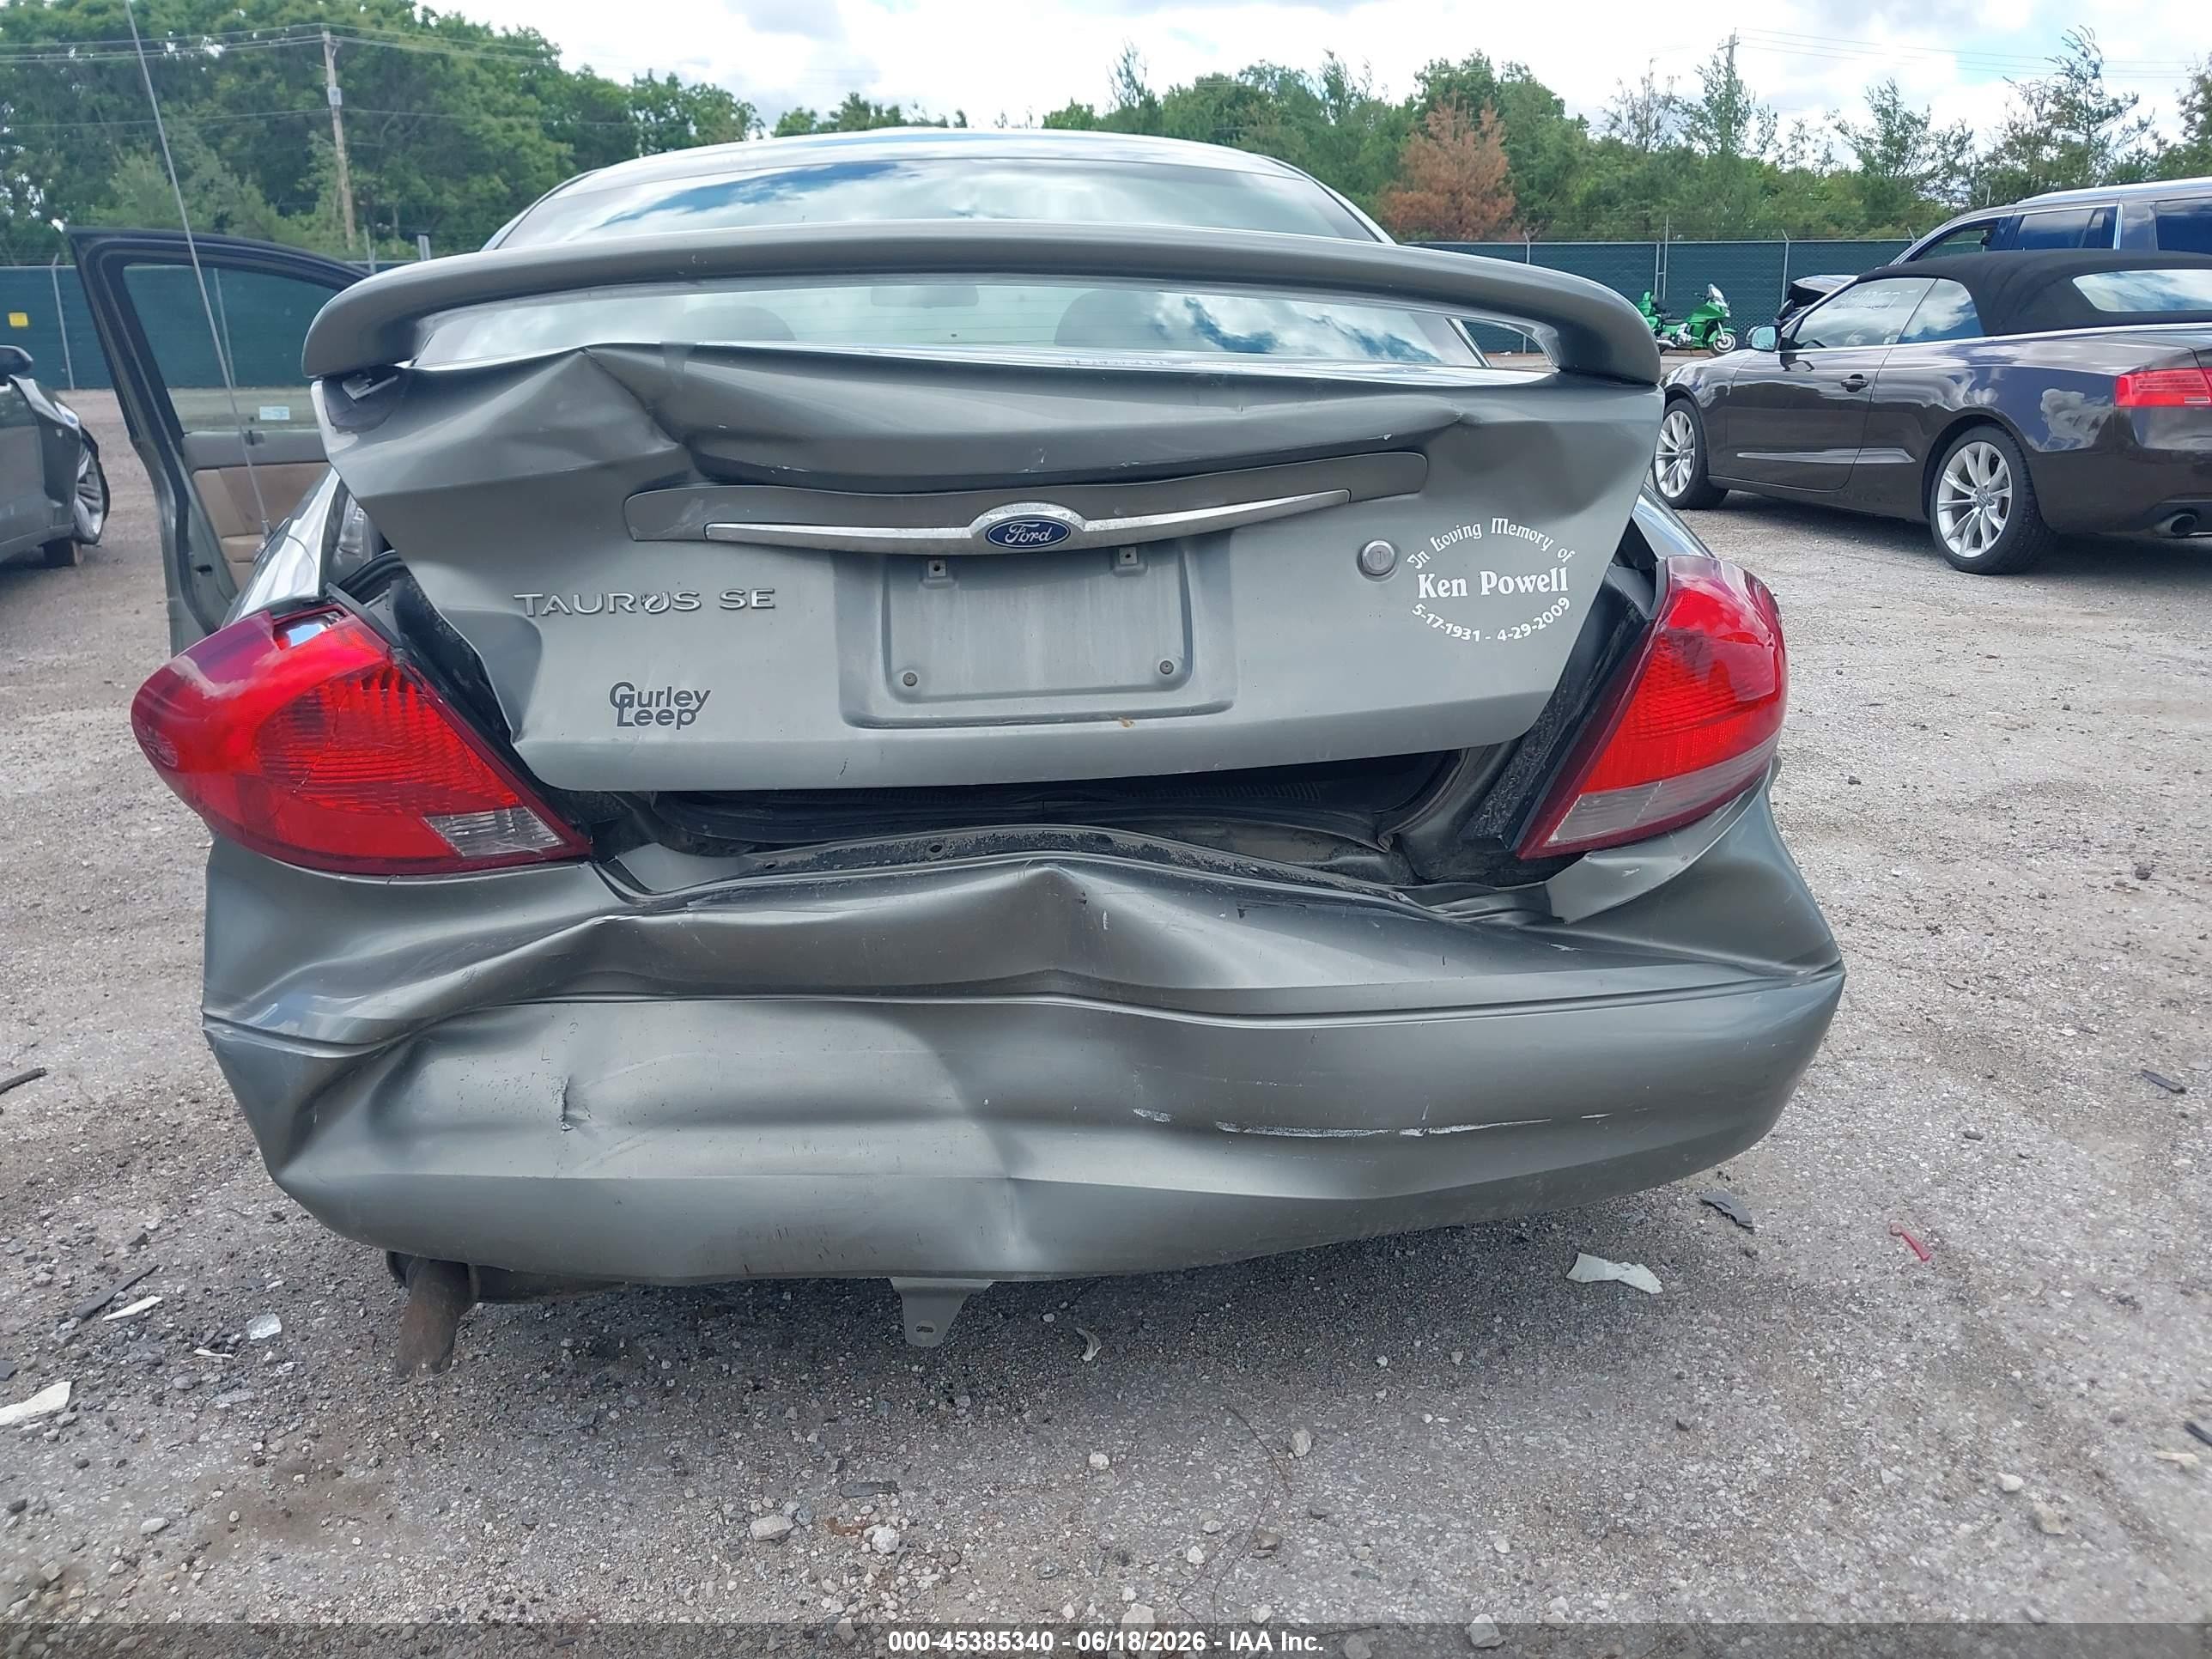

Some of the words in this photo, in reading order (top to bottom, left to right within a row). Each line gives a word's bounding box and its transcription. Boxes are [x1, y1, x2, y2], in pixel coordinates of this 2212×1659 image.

[1005, 523, 1052, 544] Ford
[1407, 550, 1431, 569] In
[1430, 522, 1483, 552] Loving
[1491, 517, 1554, 552] Memory
[1557, 547, 1576, 563] of
[1418, 573, 1468, 599] Ken
[1480, 567, 1569, 596] Powell
[514, 591, 702, 617] TAURUS
[720, 588, 775, 610] SE
[1412, 603, 1481, 641] 5-17-1931
[1497, 597, 1571, 641] 4-29-2009
[609, 681, 712, 713] Gurley
[617, 696, 696, 730] Leep
